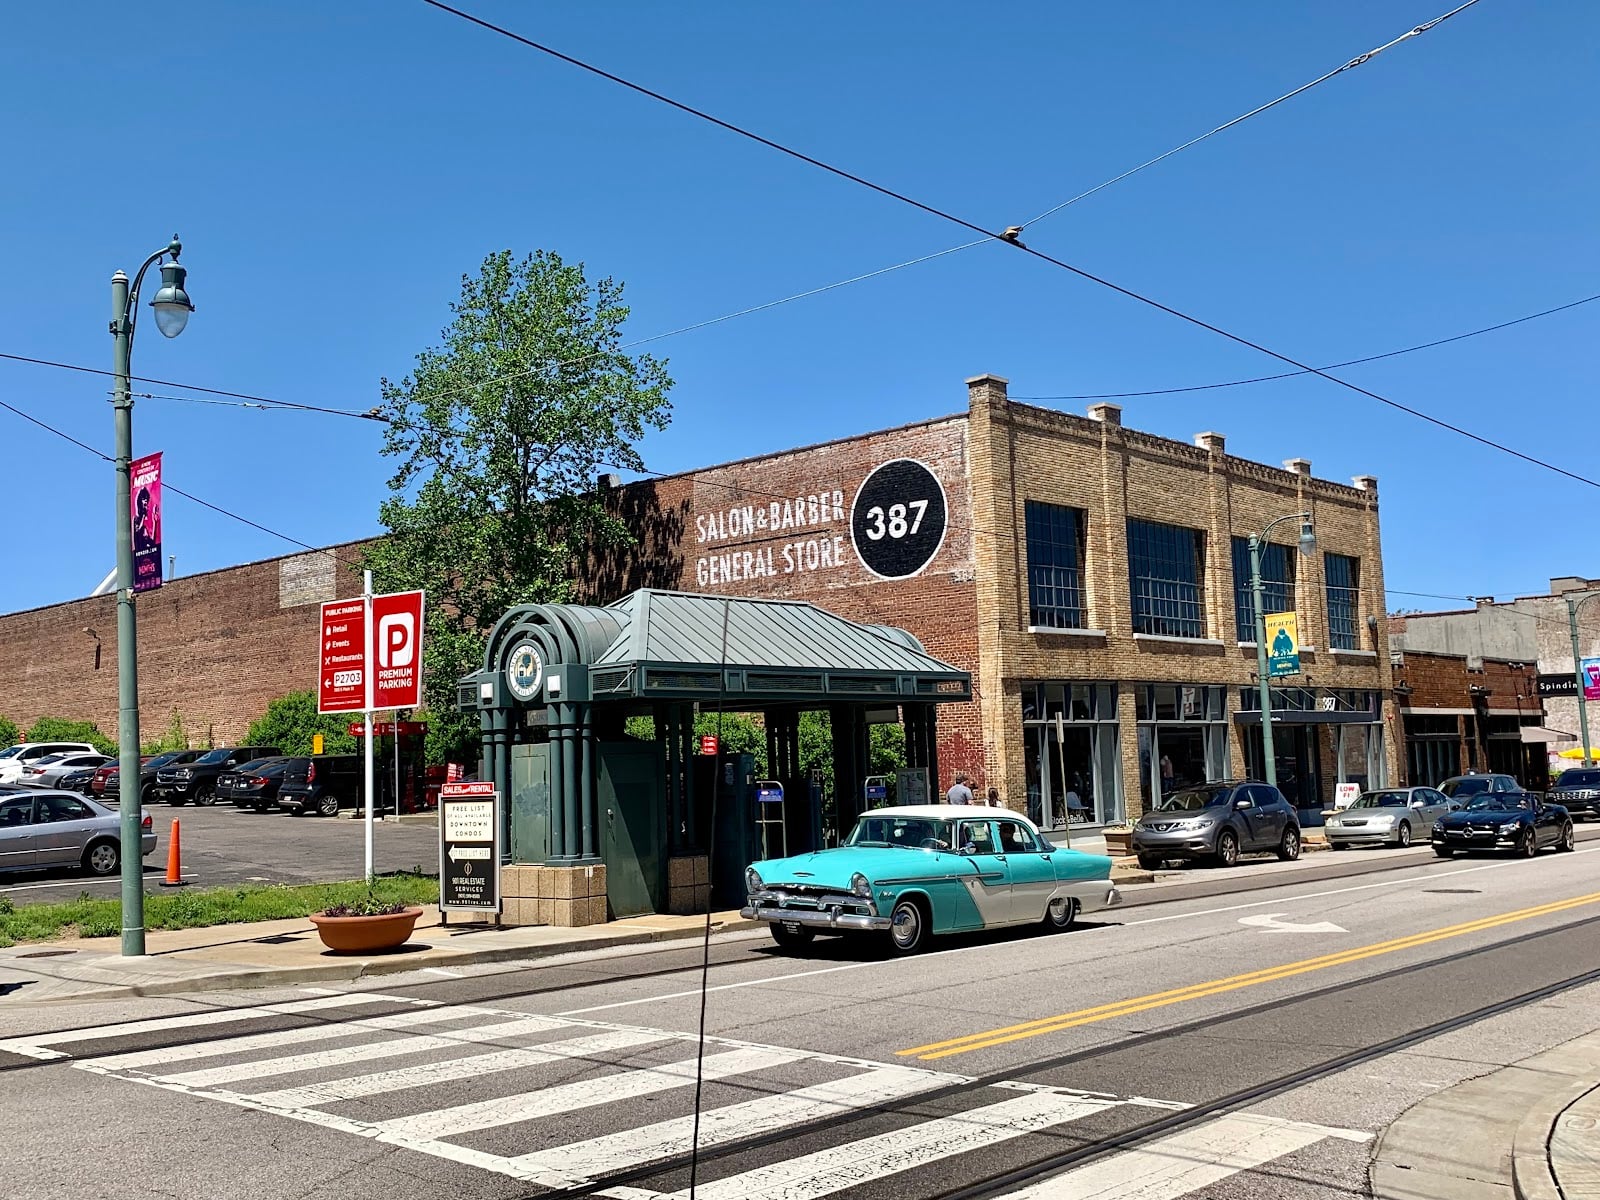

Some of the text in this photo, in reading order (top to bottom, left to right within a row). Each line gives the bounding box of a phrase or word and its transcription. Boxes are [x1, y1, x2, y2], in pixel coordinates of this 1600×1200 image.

[133, 470, 159, 488] MUSIC
[866, 500, 929, 540] 387
[697, 536, 844, 586] GENERAL STORE
[325, 605, 363, 616] PUBLIC PARKING
[332, 624, 348, 633] Retail
[332, 640, 350, 648] Events
[332, 653, 363, 663] Restaurants
[335, 672, 361, 684] P2703
[379, 668, 413, 680] PREMIUM
[379, 677, 413, 690] PARKING
[1540, 681, 1578, 691] Spindin
[1323, 697, 1336, 711] 387
[443, 785, 463, 794] SALES
[469, 784, 493, 793] RENTAL
[459, 877, 470, 885] REAL
[470, 877, 486, 885] ESTATE
